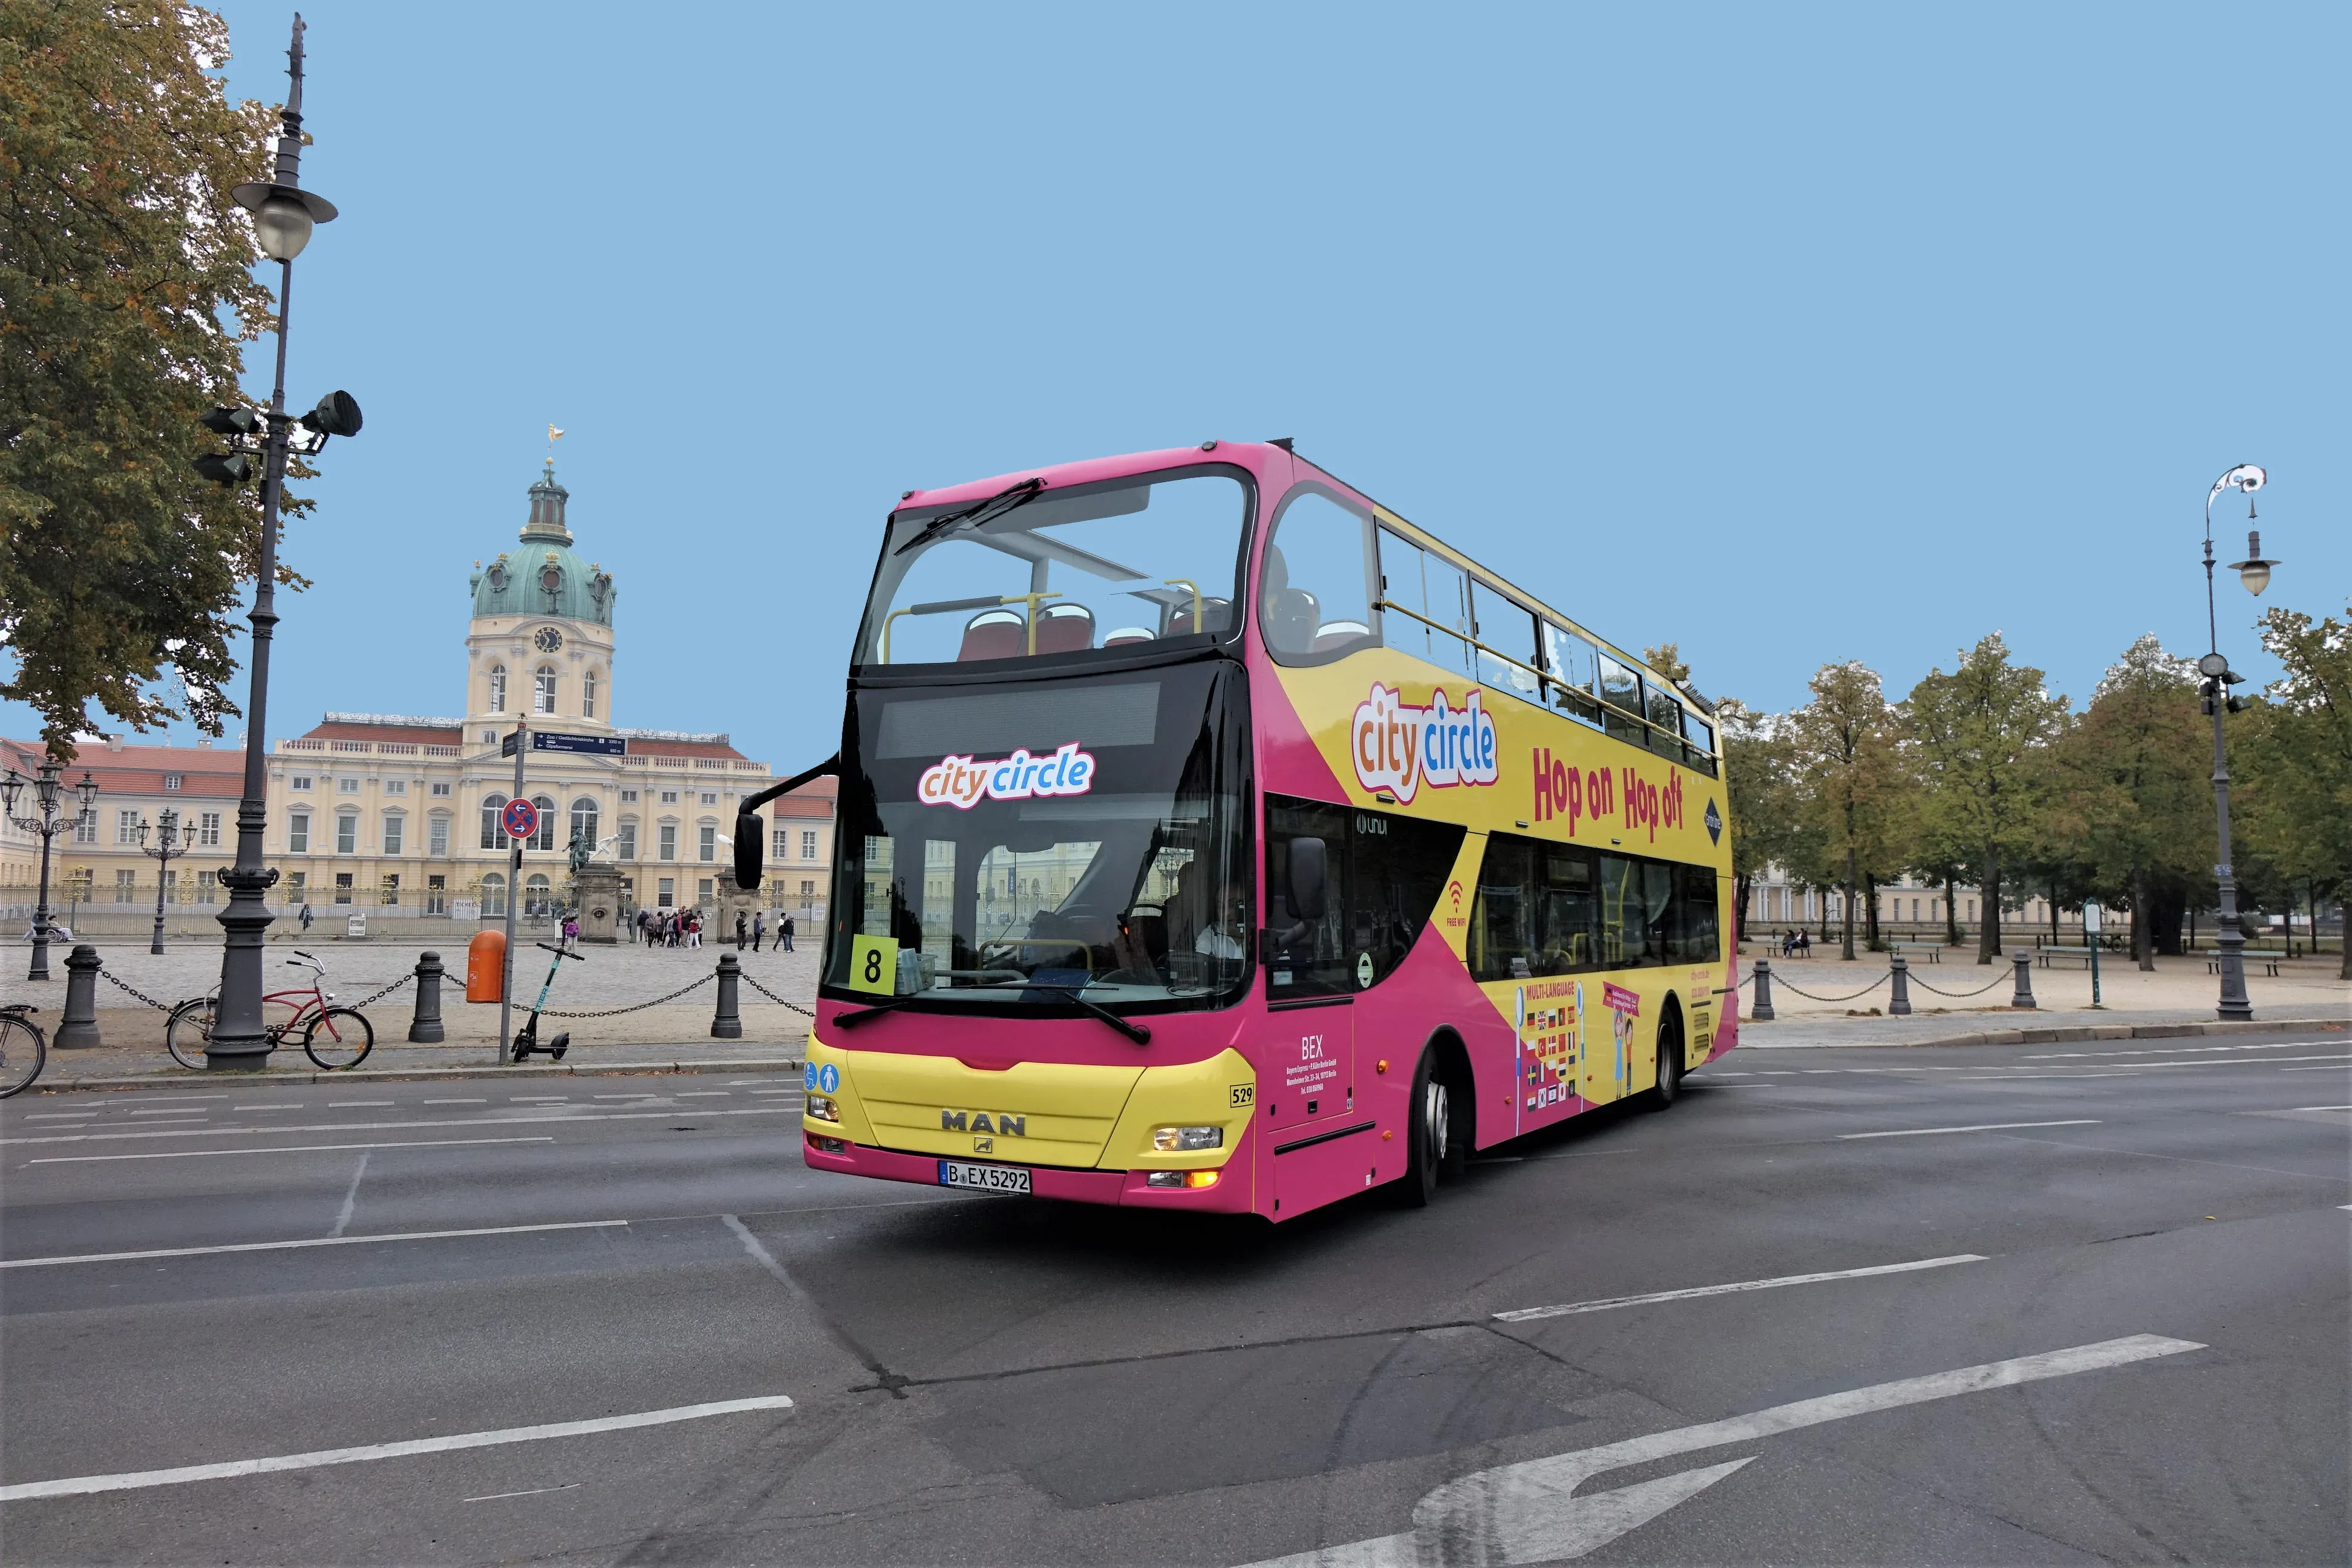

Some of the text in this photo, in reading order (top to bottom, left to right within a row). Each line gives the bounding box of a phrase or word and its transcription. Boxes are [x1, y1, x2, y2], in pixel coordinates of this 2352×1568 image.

[1359, 701, 1493, 786] city circle
[924, 753, 1088, 802] city circle
[1533, 748, 1683, 843] Hop on Hop off
[1447, 918, 1457, 926] FREE
[864, 949, 881, 983] 8
[1526, 981, 1575, 1001] MULTI-LANGUAGE
[1302, 1034, 1323, 1060] BEX
[1286, 1067, 1297, 1076] Bayern
[1297, 1065, 1308, 1074] Express
[1286, 1077, 1305, 1086] Mannheimer
[1232, 1087, 1252, 1103] 529
[942, 1108, 1027, 1135] MAN
[949, 1165, 958, 1182] B
[968, 1167, 988, 1186] EX
[990, 1169, 1028, 1190] 5292
